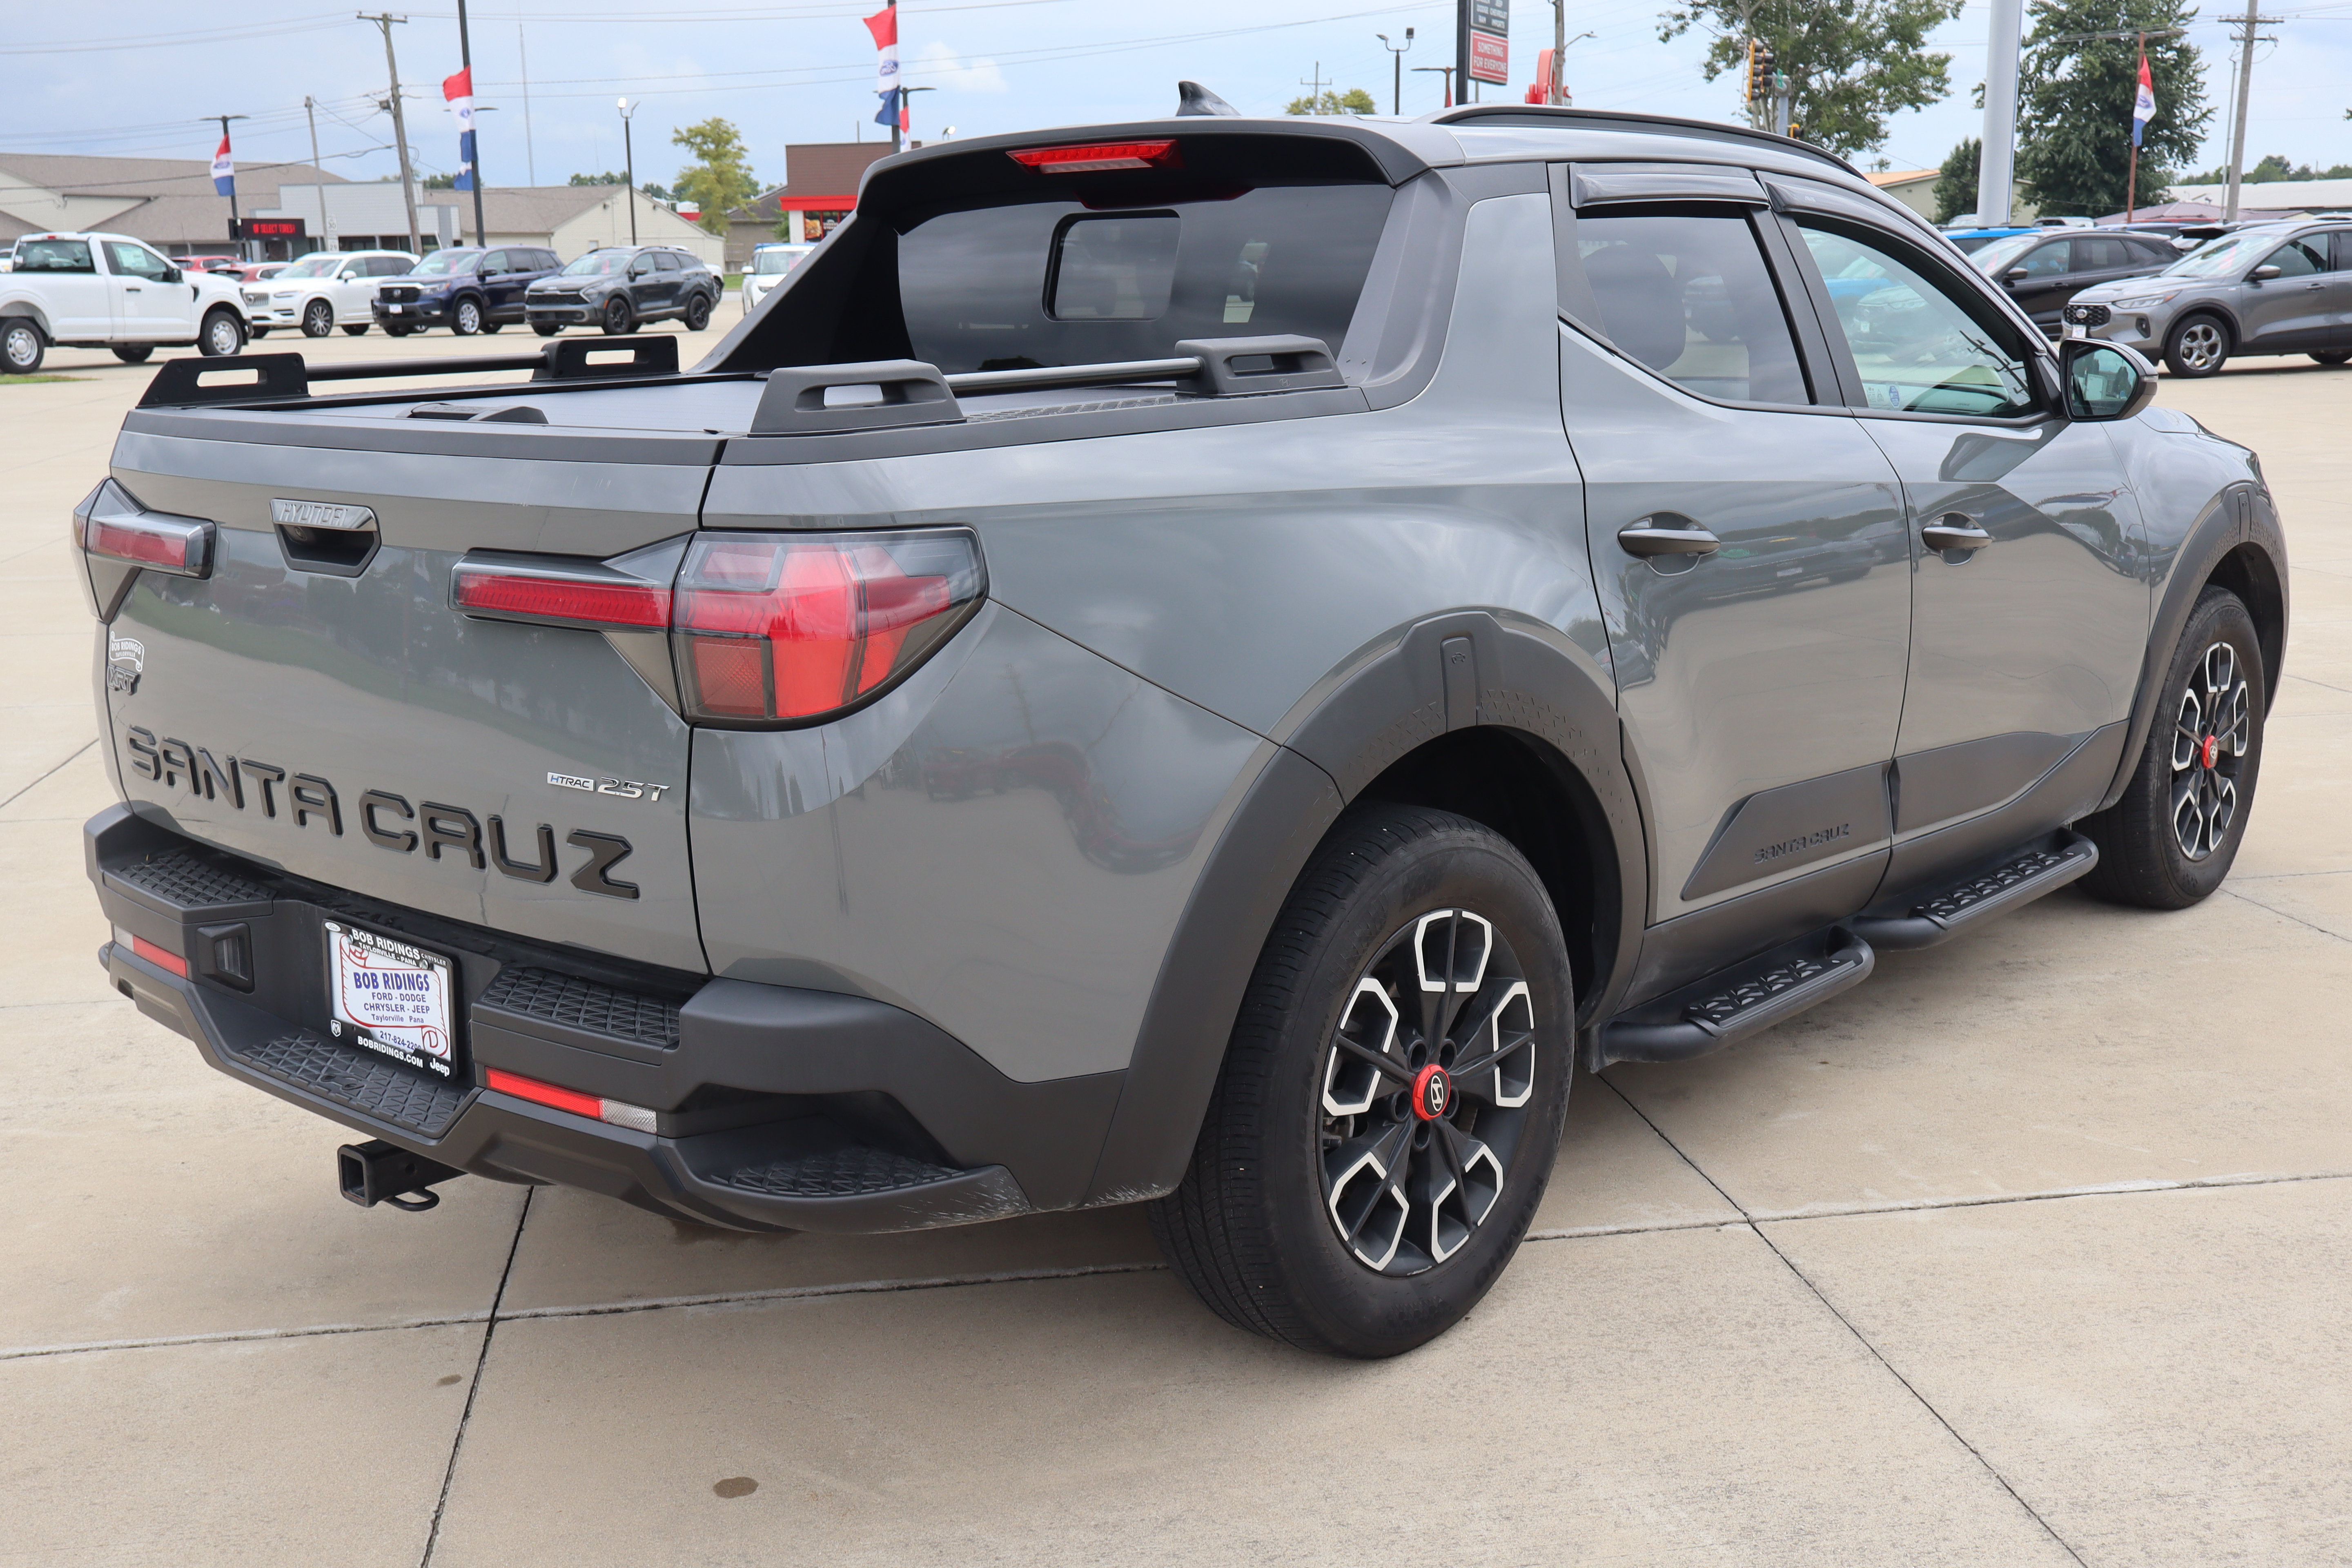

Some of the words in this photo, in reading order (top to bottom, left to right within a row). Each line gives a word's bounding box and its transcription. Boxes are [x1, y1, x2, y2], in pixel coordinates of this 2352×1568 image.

[1477, 41, 1503, 57] SOMETHING
[1474, 56, 1483, 68] FOR
[1484, 58, 1507, 73] EVERYONE
[279, 503, 348, 527] HYUNDAI
[111, 642, 120, 651] BOB
[121, 641, 141, 655] RIDINGS
[107, 665, 140, 694] XRT
[550, 775, 590, 788] HTRAC
[127, 725, 344, 837] SANTA
[359, 789, 640, 900] CRUZ
[1754, 836, 1807, 864] SANTA
[1810, 823, 1849, 846] CRUZ
[352, 929, 374, 946] BOB
[376, 936, 420, 960] RIDINGS
[359, 942, 396, 960] TAYLORVILLE
[401, 956, 417, 967] PANA
[421, 953, 446, 966] CHRYSLER
[353, 972, 379, 989] BOB
[382, 972, 430, 991] RIDINGS
[372, 992, 393, 1001] FORD
[399, 993, 426, 1002] DODGE
[364, 1002, 405, 1013] CHRYSLER
[412, 1004, 430, 1014] JEEP
[371, 1013, 404, 1022] Taylorville
[357, 1036, 423, 1068] BOBRIDINGS.COM
[430, 1058, 450, 1077] Jeep
